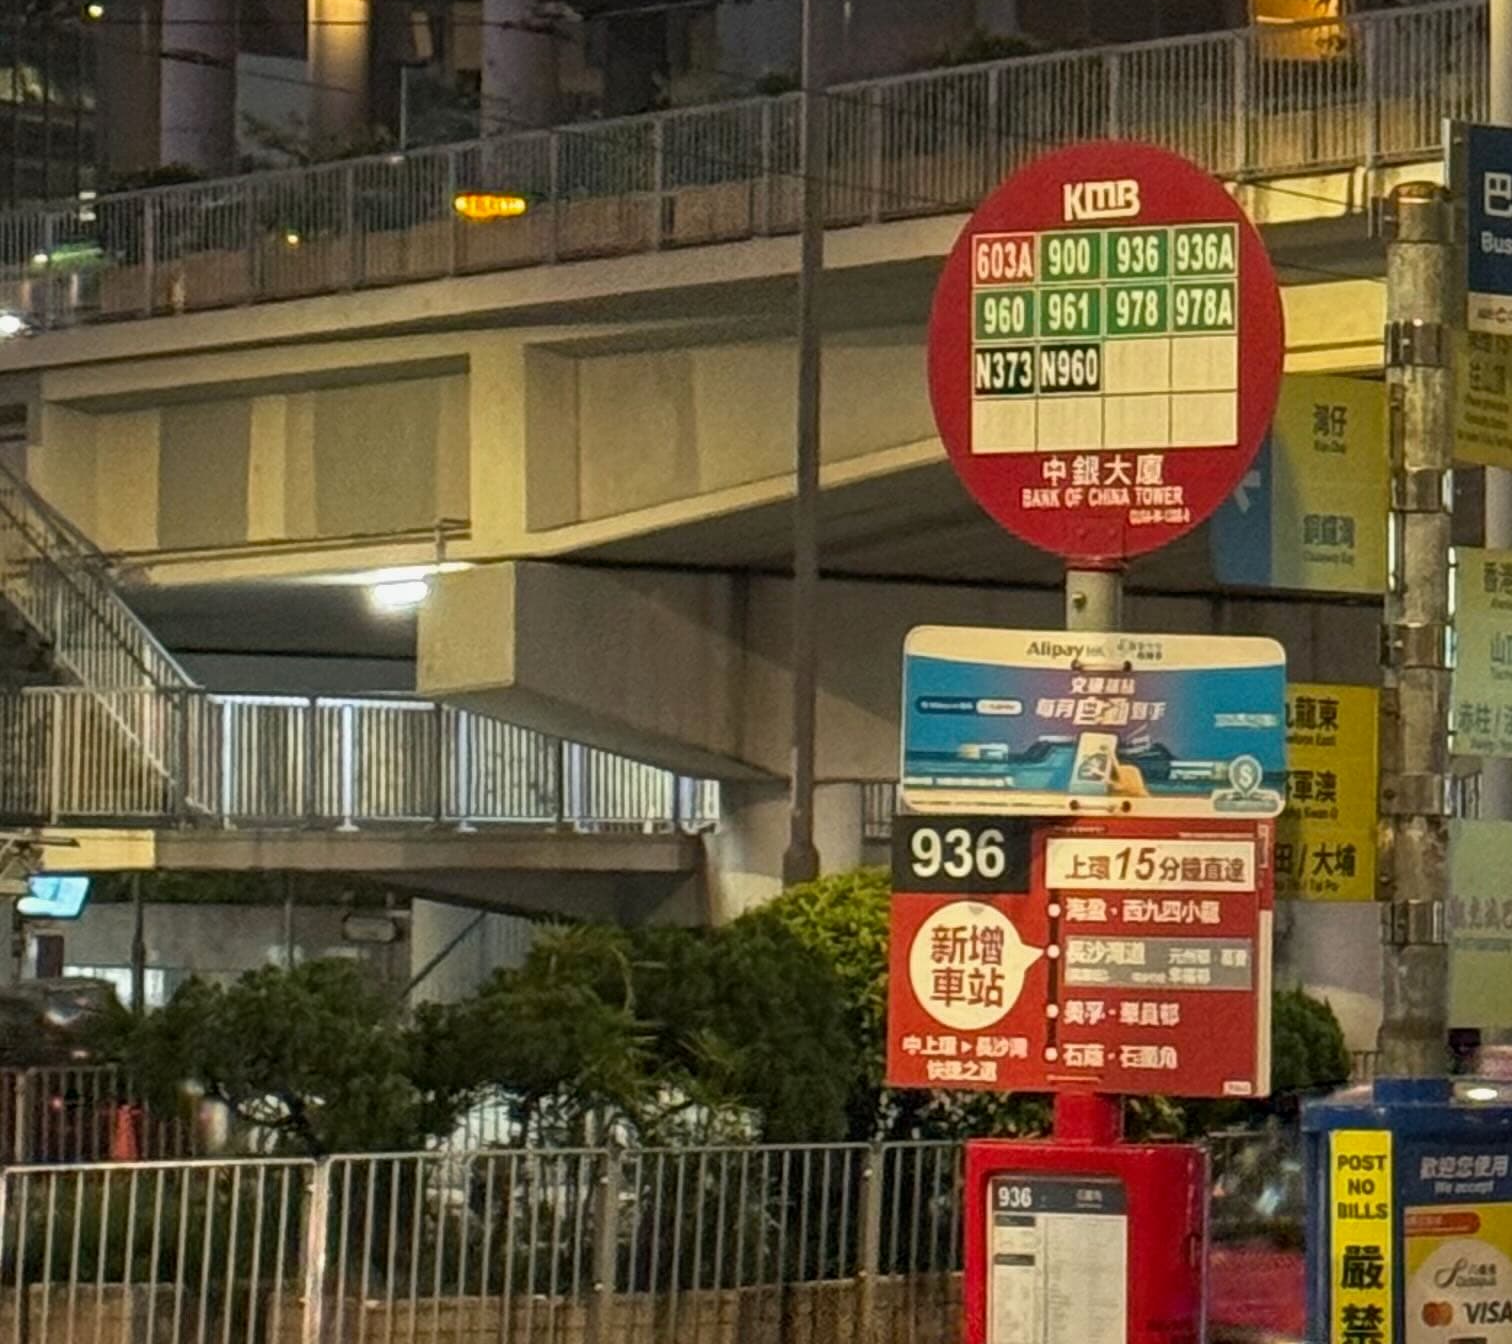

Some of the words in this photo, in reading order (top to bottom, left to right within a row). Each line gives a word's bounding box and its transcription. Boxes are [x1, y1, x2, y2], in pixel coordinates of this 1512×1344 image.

[1063, 180, 1140, 221] KMB
[976, 242, 1033, 279] 603A
[1048, 238, 1091, 274] 900
[1117, 236, 1159, 271] 936
[1176, 233, 1234, 269] 936A
[1481, 232, 1512, 254] Bus
[984, 296, 1025, 334] 960
[1048, 292, 1090, 330] 961
[1116, 289, 1158, 327] 978
[1176, 287, 1233, 326] 978A
[975, 351, 1033, 388] N373
[1042, 349, 1098, 385] N960
[1043, 455, 1163, 486] 中銀大廈
[1022, 488, 1058, 508] BANK
[1064, 488, 1082, 507] OF
[1088, 487, 1130, 506] CHINA
[1135, 486, 1183, 505] TOWER
[1027, 641, 1084, 666] Alipay
[911, 828, 1006, 880] 936
[931, 924, 1005, 964] 新增
[931, 967, 1005, 1008] 車站
[1337, 1155, 1387, 1172] POST
[998, 1186, 1033, 1208] 936
[1348, 1179, 1376, 1196] NO
[1337, 1203, 1389, 1220] BILLS
